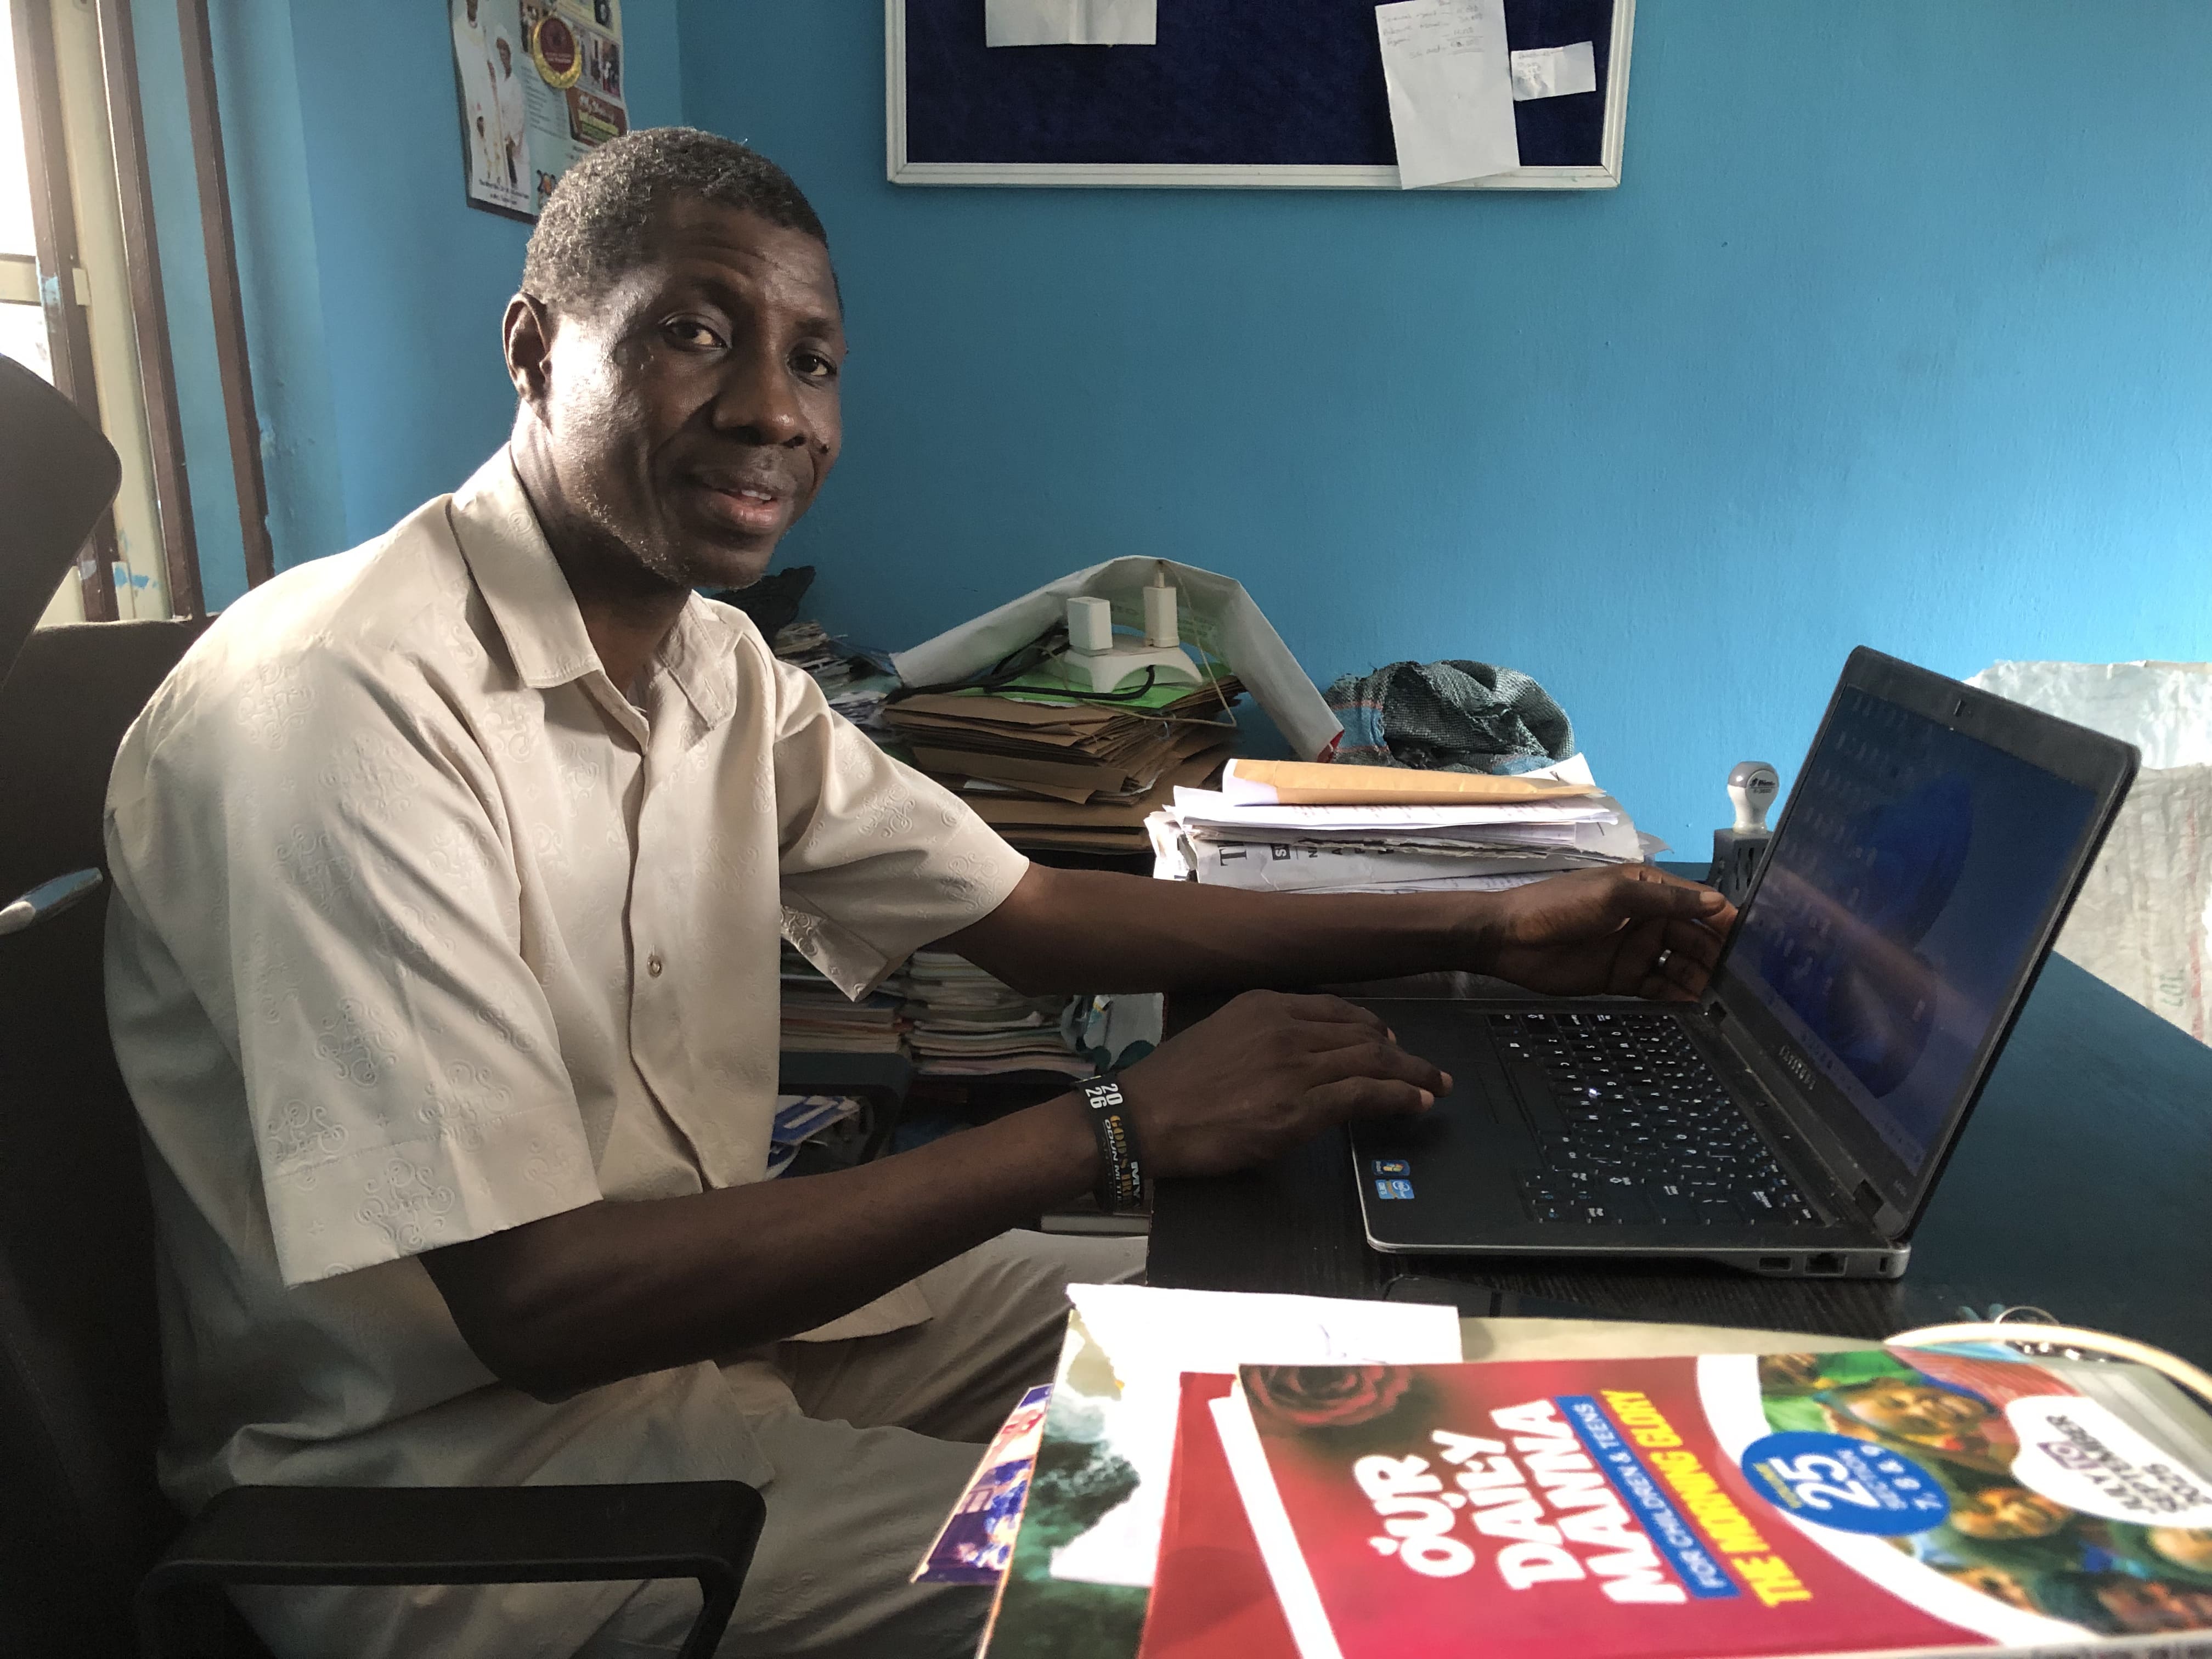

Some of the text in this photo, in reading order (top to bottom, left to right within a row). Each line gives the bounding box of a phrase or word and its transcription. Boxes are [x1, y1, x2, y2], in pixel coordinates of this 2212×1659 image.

[1085, 1087, 1107, 1109] 26
[1101, 1083, 1124, 1105] 20
[1105, 1119, 1119, 1161] ODUN
[1353, 1454, 1475, 1578] OUR
[1431, 1430, 1587, 1590] DAILY
[1489, 1399, 1687, 1604] MANNA
[1572, 1403, 1728, 1589] FOR CHILDREN & TEENS
[1600, 1389, 1813, 1608] THE MORNING GLORY
[1767, 1454, 1881, 1510] 25
